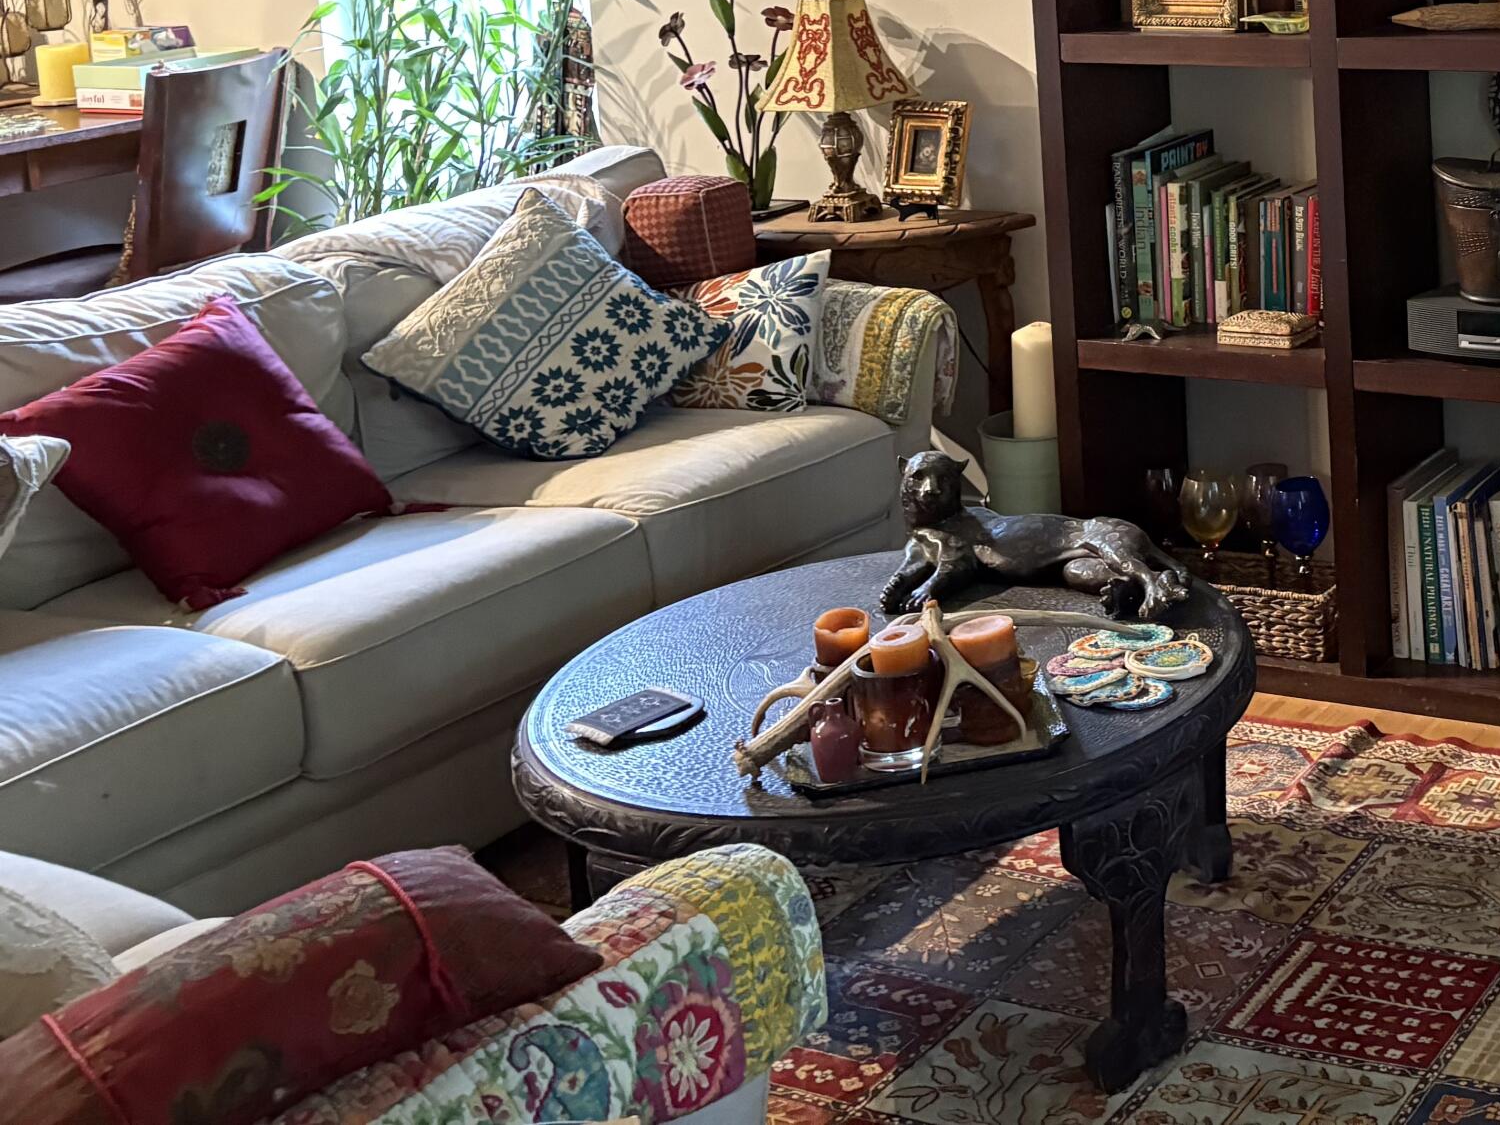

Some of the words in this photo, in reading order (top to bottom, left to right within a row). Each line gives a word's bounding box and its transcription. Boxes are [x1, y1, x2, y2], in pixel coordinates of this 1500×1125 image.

[1161, 141, 1195, 172] PAINT
[1112, 162, 1124, 228] RAINFORESTS
[1118, 239, 1128, 279] WORLD
[1135, 206, 1147, 250] Indian
[1228, 221, 1237, 243] GOOD
[1229, 243, 1238, 269] GRITS!
[1423, 537, 1436, 583] NATURAL
[1440, 568, 1451, 592] GREAT
[1426, 585, 1439, 639] PHARMACY
[1441, 595, 1453, 611] ART
